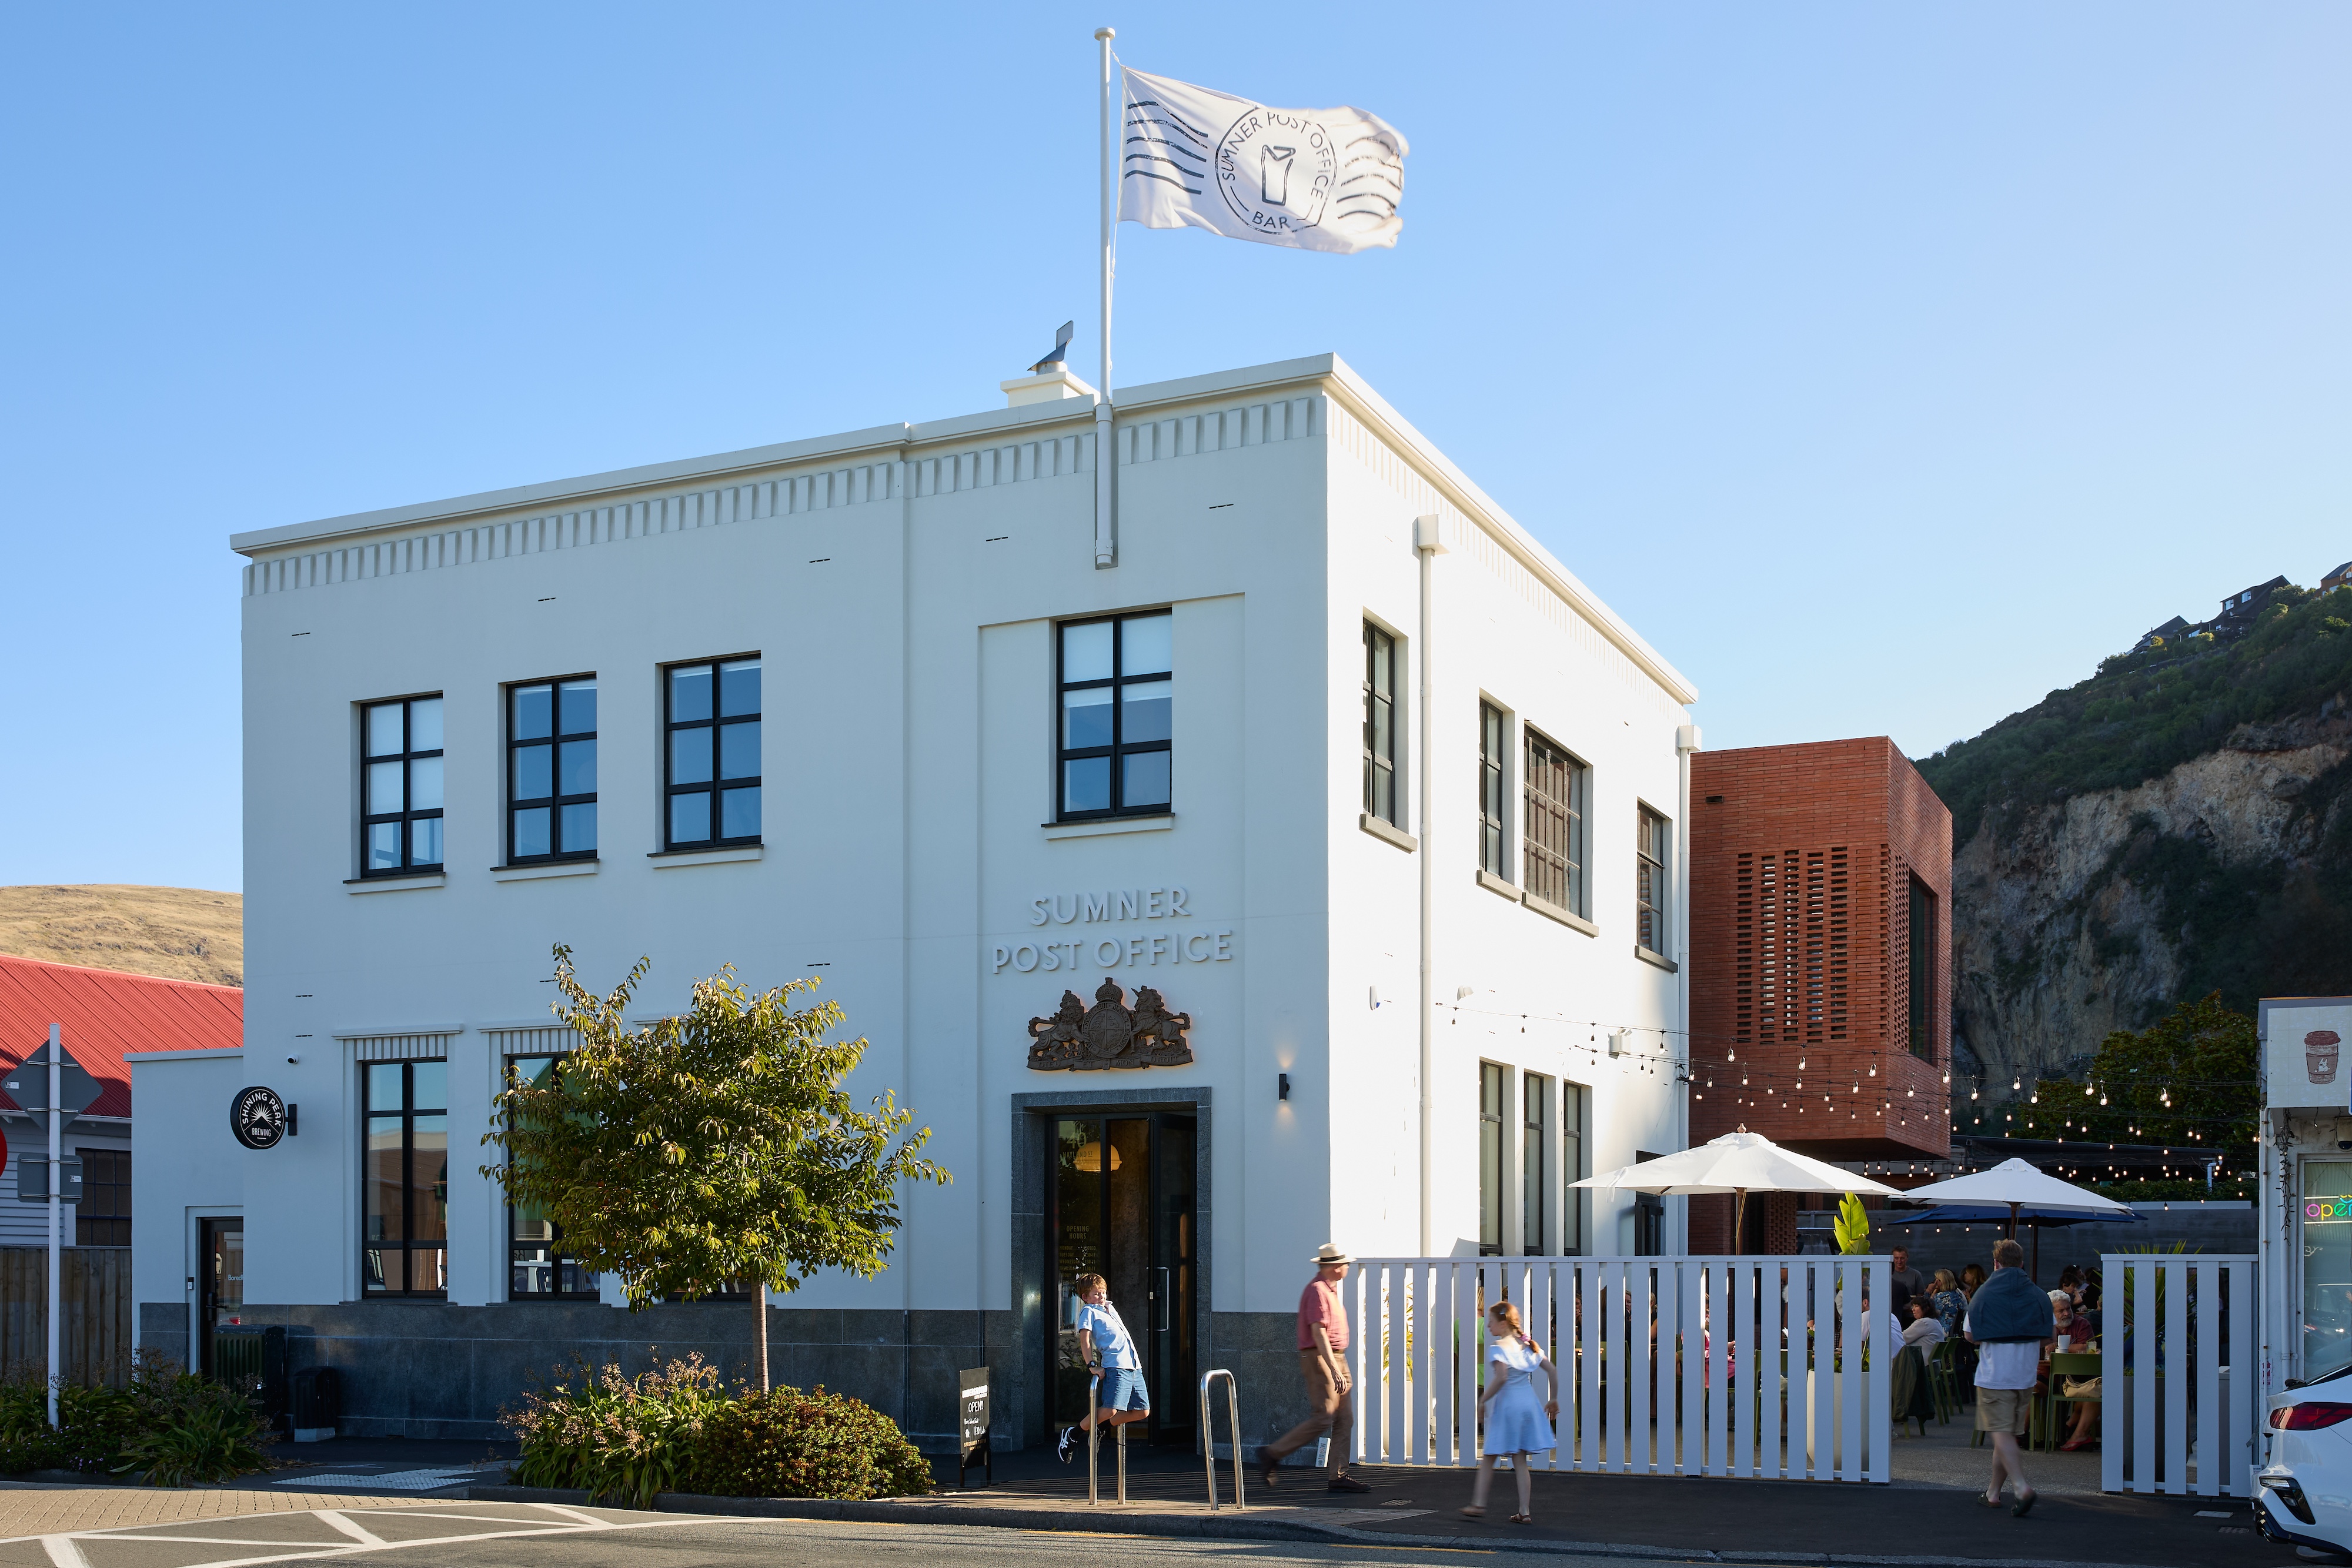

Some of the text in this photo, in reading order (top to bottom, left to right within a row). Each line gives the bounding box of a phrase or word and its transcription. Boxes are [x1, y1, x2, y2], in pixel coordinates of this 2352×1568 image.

[1221, 112, 1331, 200] SUMNER POST OFFICE
[1252, 211, 1291, 230] BAR
[1030, 886, 1191, 926] SUMNER
[992, 929, 1232, 974] POST OFFICE
[242, 1092, 281, 1127] SHINING PEAK
[252, 1128, 272, 1137] BREWING
[1066, 1132, 1087, 1149] 40
